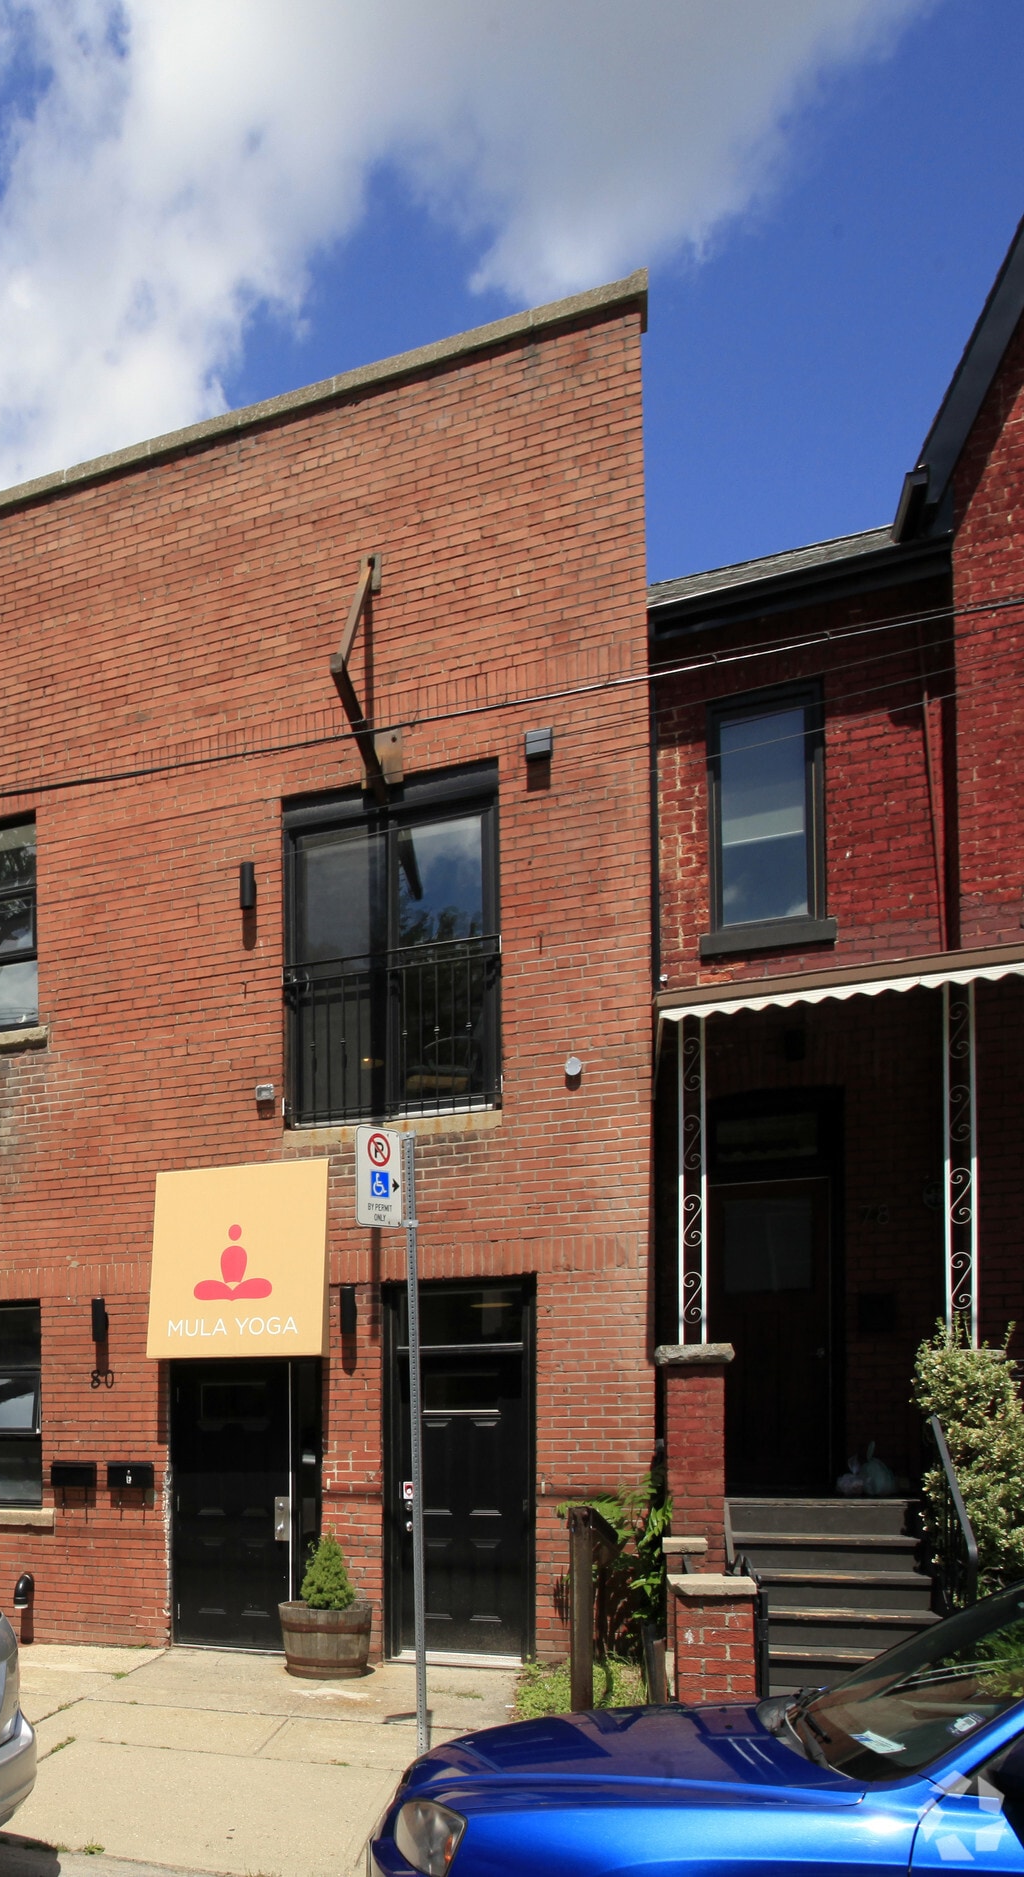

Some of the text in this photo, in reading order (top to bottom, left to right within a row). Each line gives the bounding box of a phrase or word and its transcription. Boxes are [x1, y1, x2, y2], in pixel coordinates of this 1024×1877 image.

[367, 1203, 392, 1212] BY PERMIT
[374, 1213, 387, 1222] ONLY
[858, 1204, 890, 1225] 78
[167, 1316, 299, 1337] MULA YOGA
[91, 1369, 115, 1389] 80
